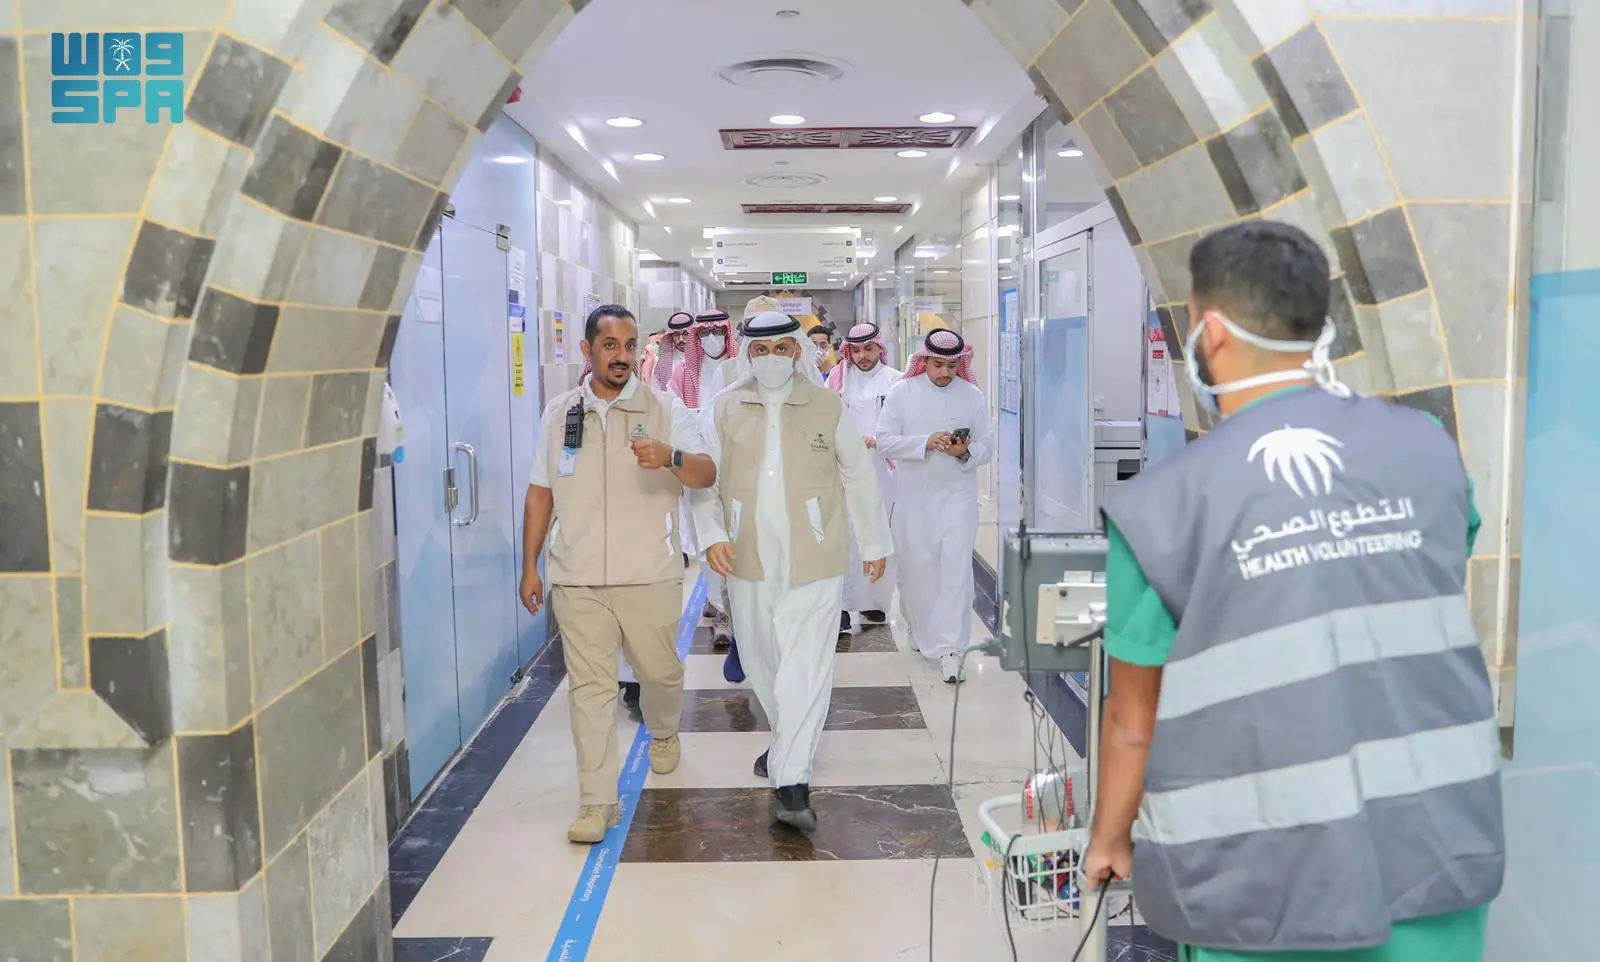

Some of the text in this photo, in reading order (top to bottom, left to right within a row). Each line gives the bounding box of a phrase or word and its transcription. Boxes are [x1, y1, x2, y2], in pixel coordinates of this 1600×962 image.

[1231, 497, 1414, 560] التطوع الصحي
[1238, 529, 1423, 581] HEALTH VOLUNTEERING
